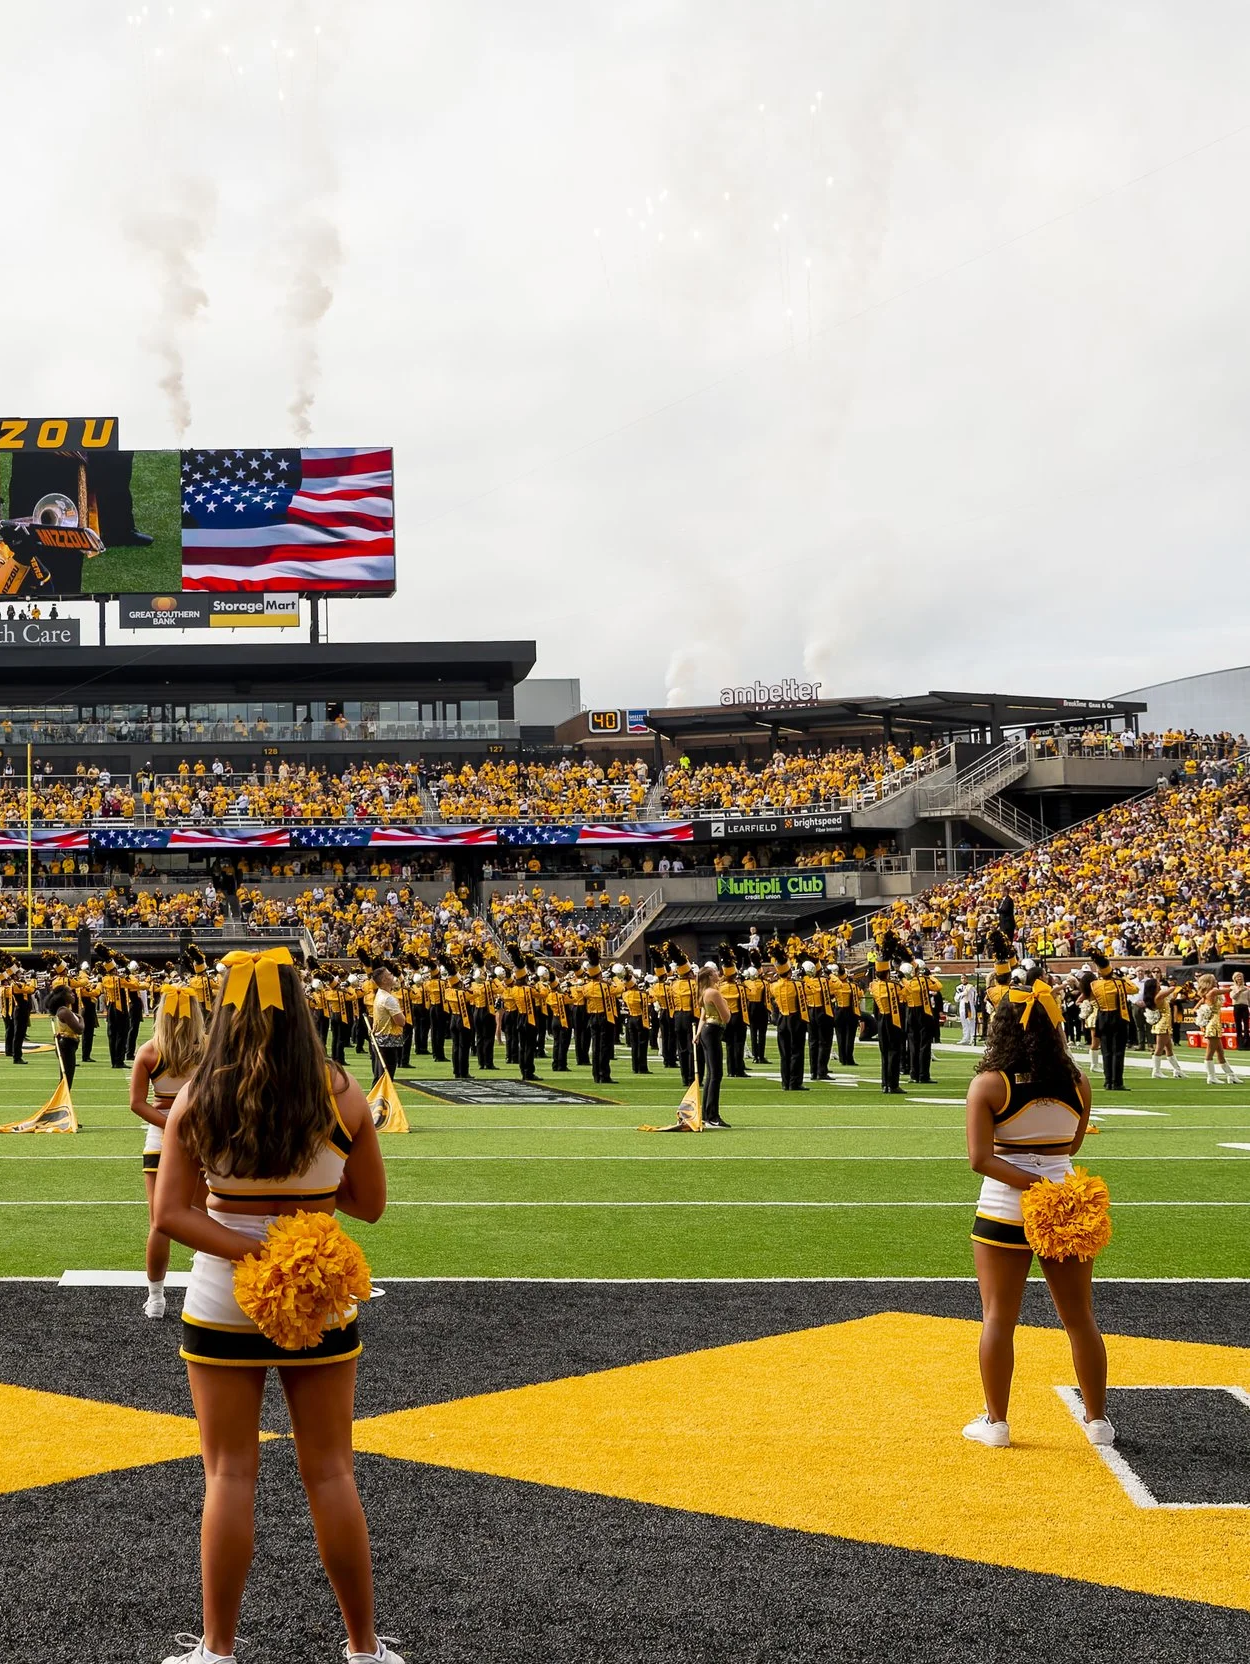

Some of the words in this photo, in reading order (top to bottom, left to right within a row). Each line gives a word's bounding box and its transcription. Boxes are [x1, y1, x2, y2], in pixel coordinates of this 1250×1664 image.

[36, 528, 90, 549] MIZZOU
[129, 611, 155, 619] GREAT
[156, 610, 200, 618] SOUTHERN
[22, 623, 71, 644] Care
[720, 678, 822, 706] ambetter
[594, 713, 615, 728] 40
[728, 824, 777, 833] LEARFIELD
[793, 816, 842, 829] brightspeed
[717, 877, 782, 899] Multipli
[787, 876, 823, 893] Club
[1189, 1036, 1195, 1045] G
[1227, 1038, 1233, 1047] G
